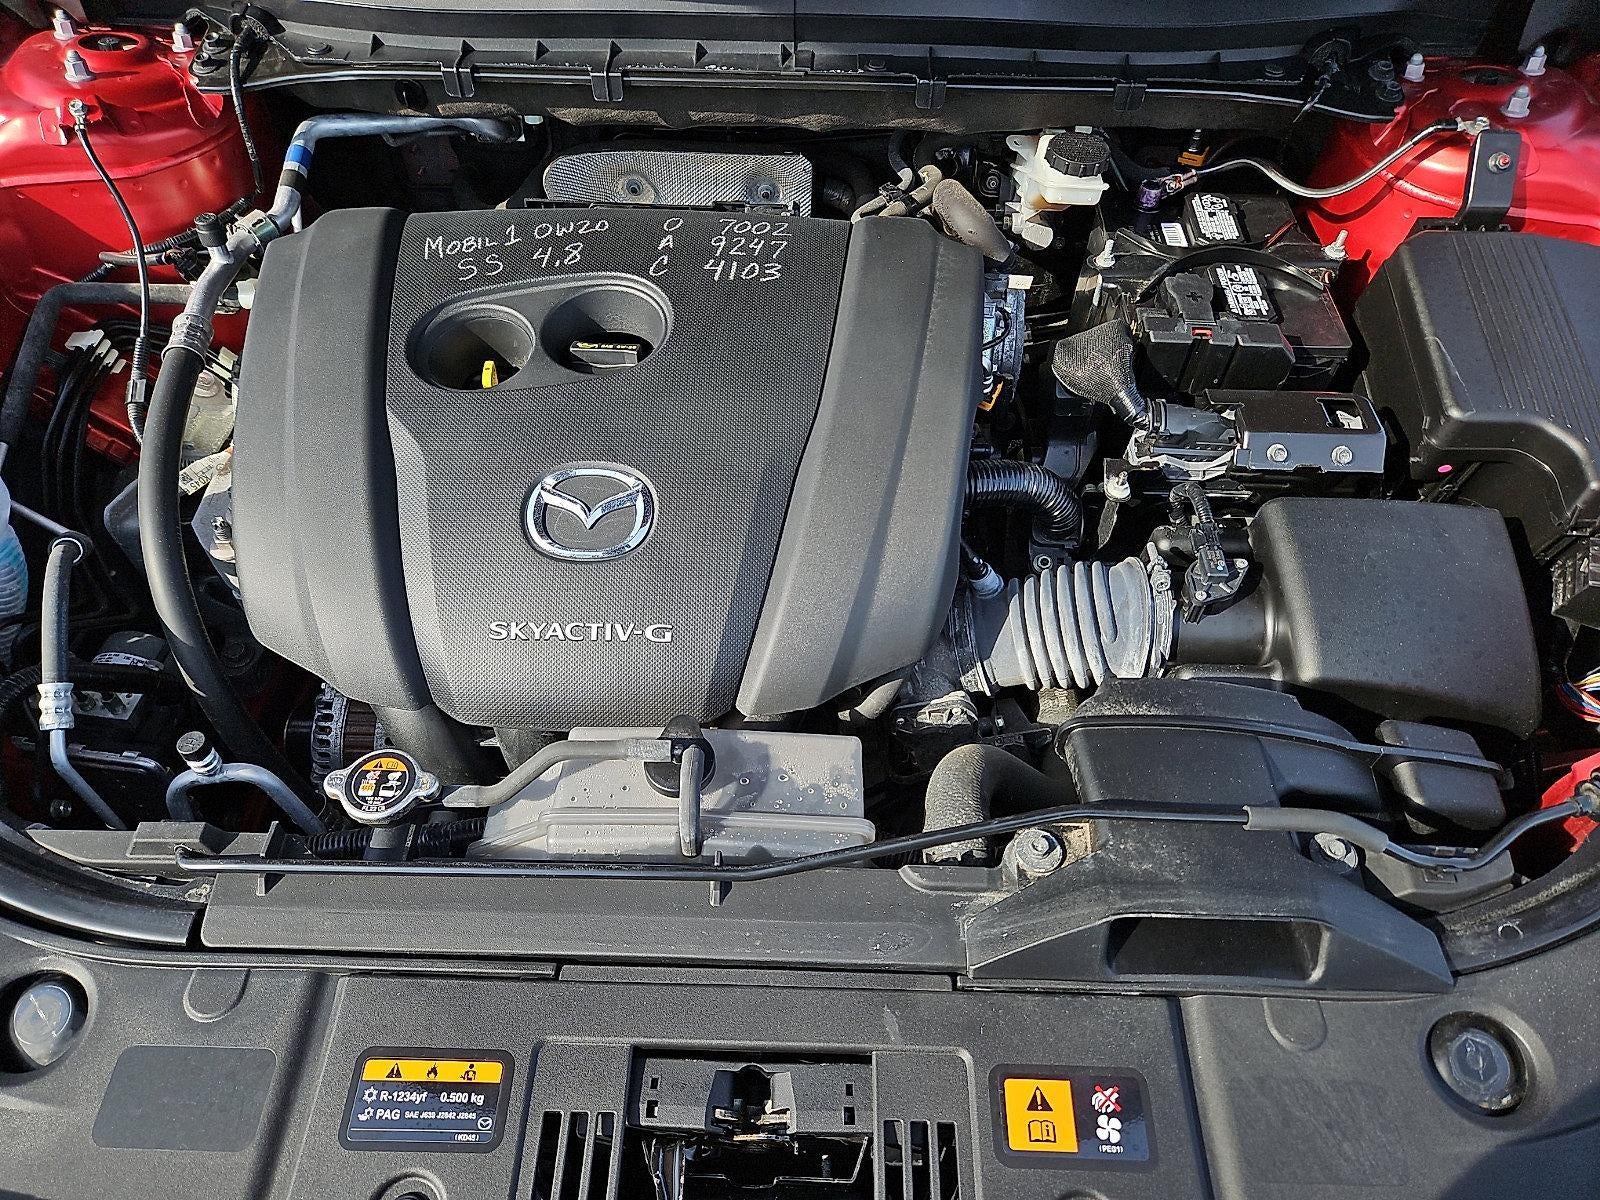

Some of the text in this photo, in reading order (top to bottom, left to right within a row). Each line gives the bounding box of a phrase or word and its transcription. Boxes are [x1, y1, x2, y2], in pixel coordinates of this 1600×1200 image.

[720, 218, 792, 236] 7002
[424, 234, 497, 260] MOBIL
[505, 224, 522, 245] 1
[657, 234, 787, 259] A 9247
[649, 254, 781, 282] C 4103
[487, 620, 674, 644] SKYACTIV-G
[380, 1090, 485, 1106] R-1234yf 0.500 kg
[375, 1108, 401, 1121] PAG
[404, 1111, 419, 1119] SAE
